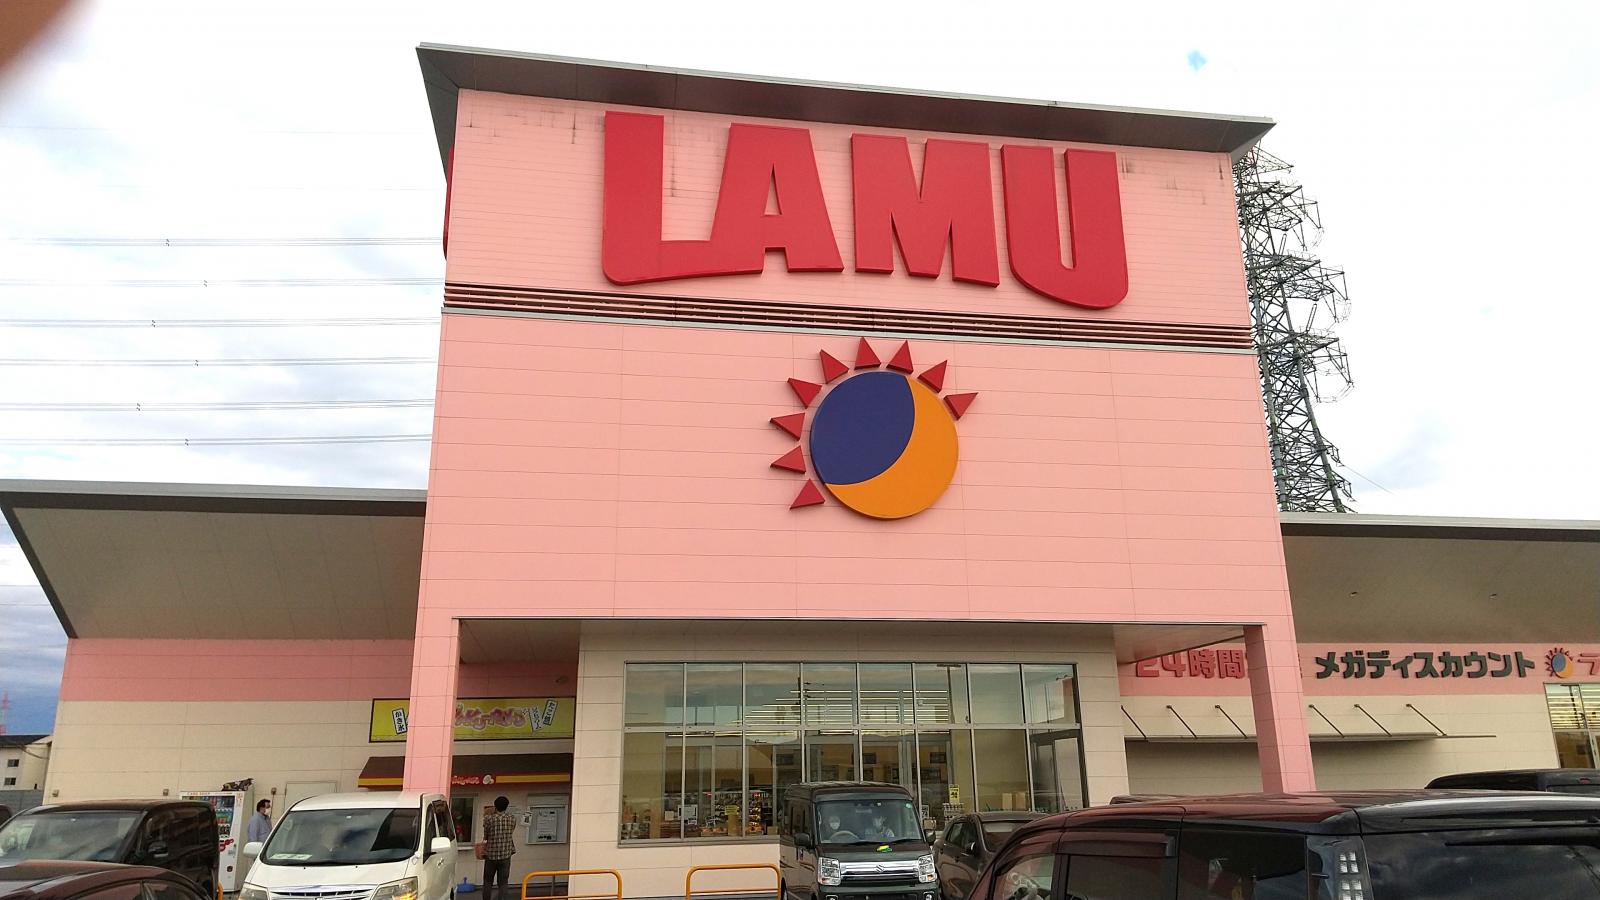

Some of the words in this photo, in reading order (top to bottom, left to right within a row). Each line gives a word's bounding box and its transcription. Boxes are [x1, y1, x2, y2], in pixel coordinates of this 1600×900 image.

[602, 111, 1129, 309] LAMU
[1136, 649, 1249, 679] 24時間
[1315, 650, 1535, 679] メガディスカウント
